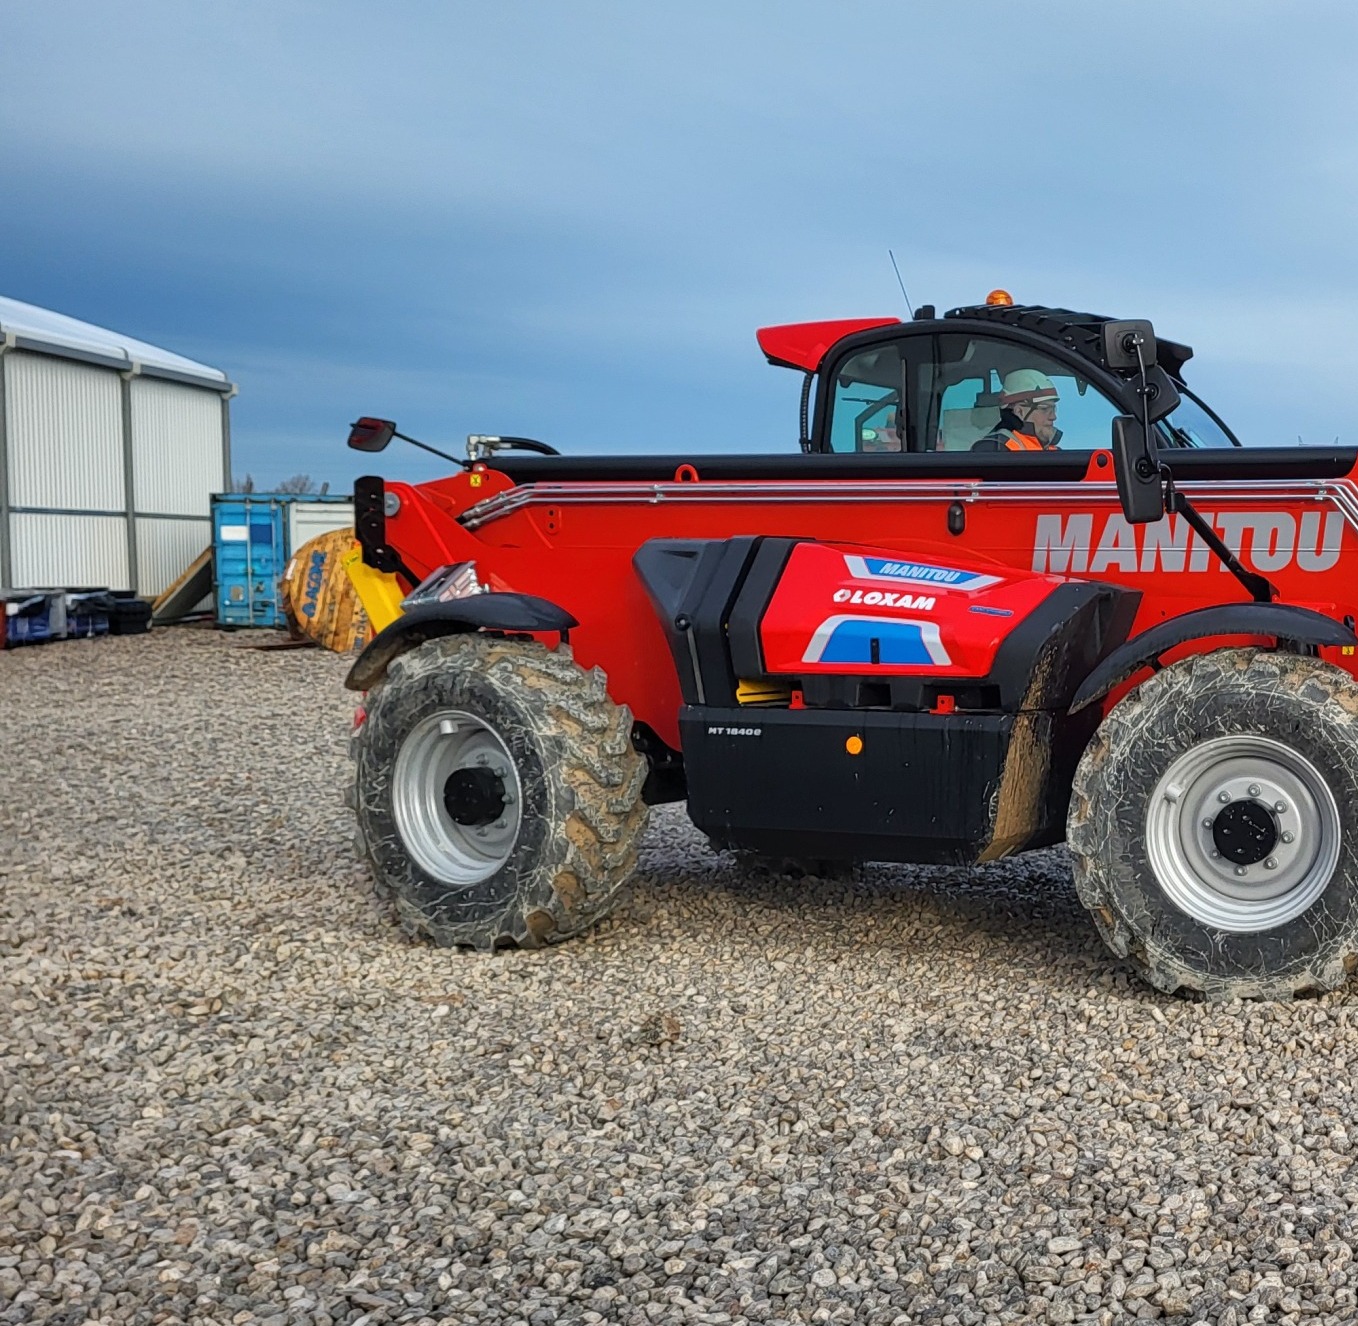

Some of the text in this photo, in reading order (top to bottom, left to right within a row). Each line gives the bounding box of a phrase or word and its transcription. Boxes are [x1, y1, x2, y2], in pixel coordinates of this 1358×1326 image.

[1031, 511, 1346, 574] MANITOU
[879, 562, 962, 583] MANITOU
[850, 590, 937, 611] LOXAM
